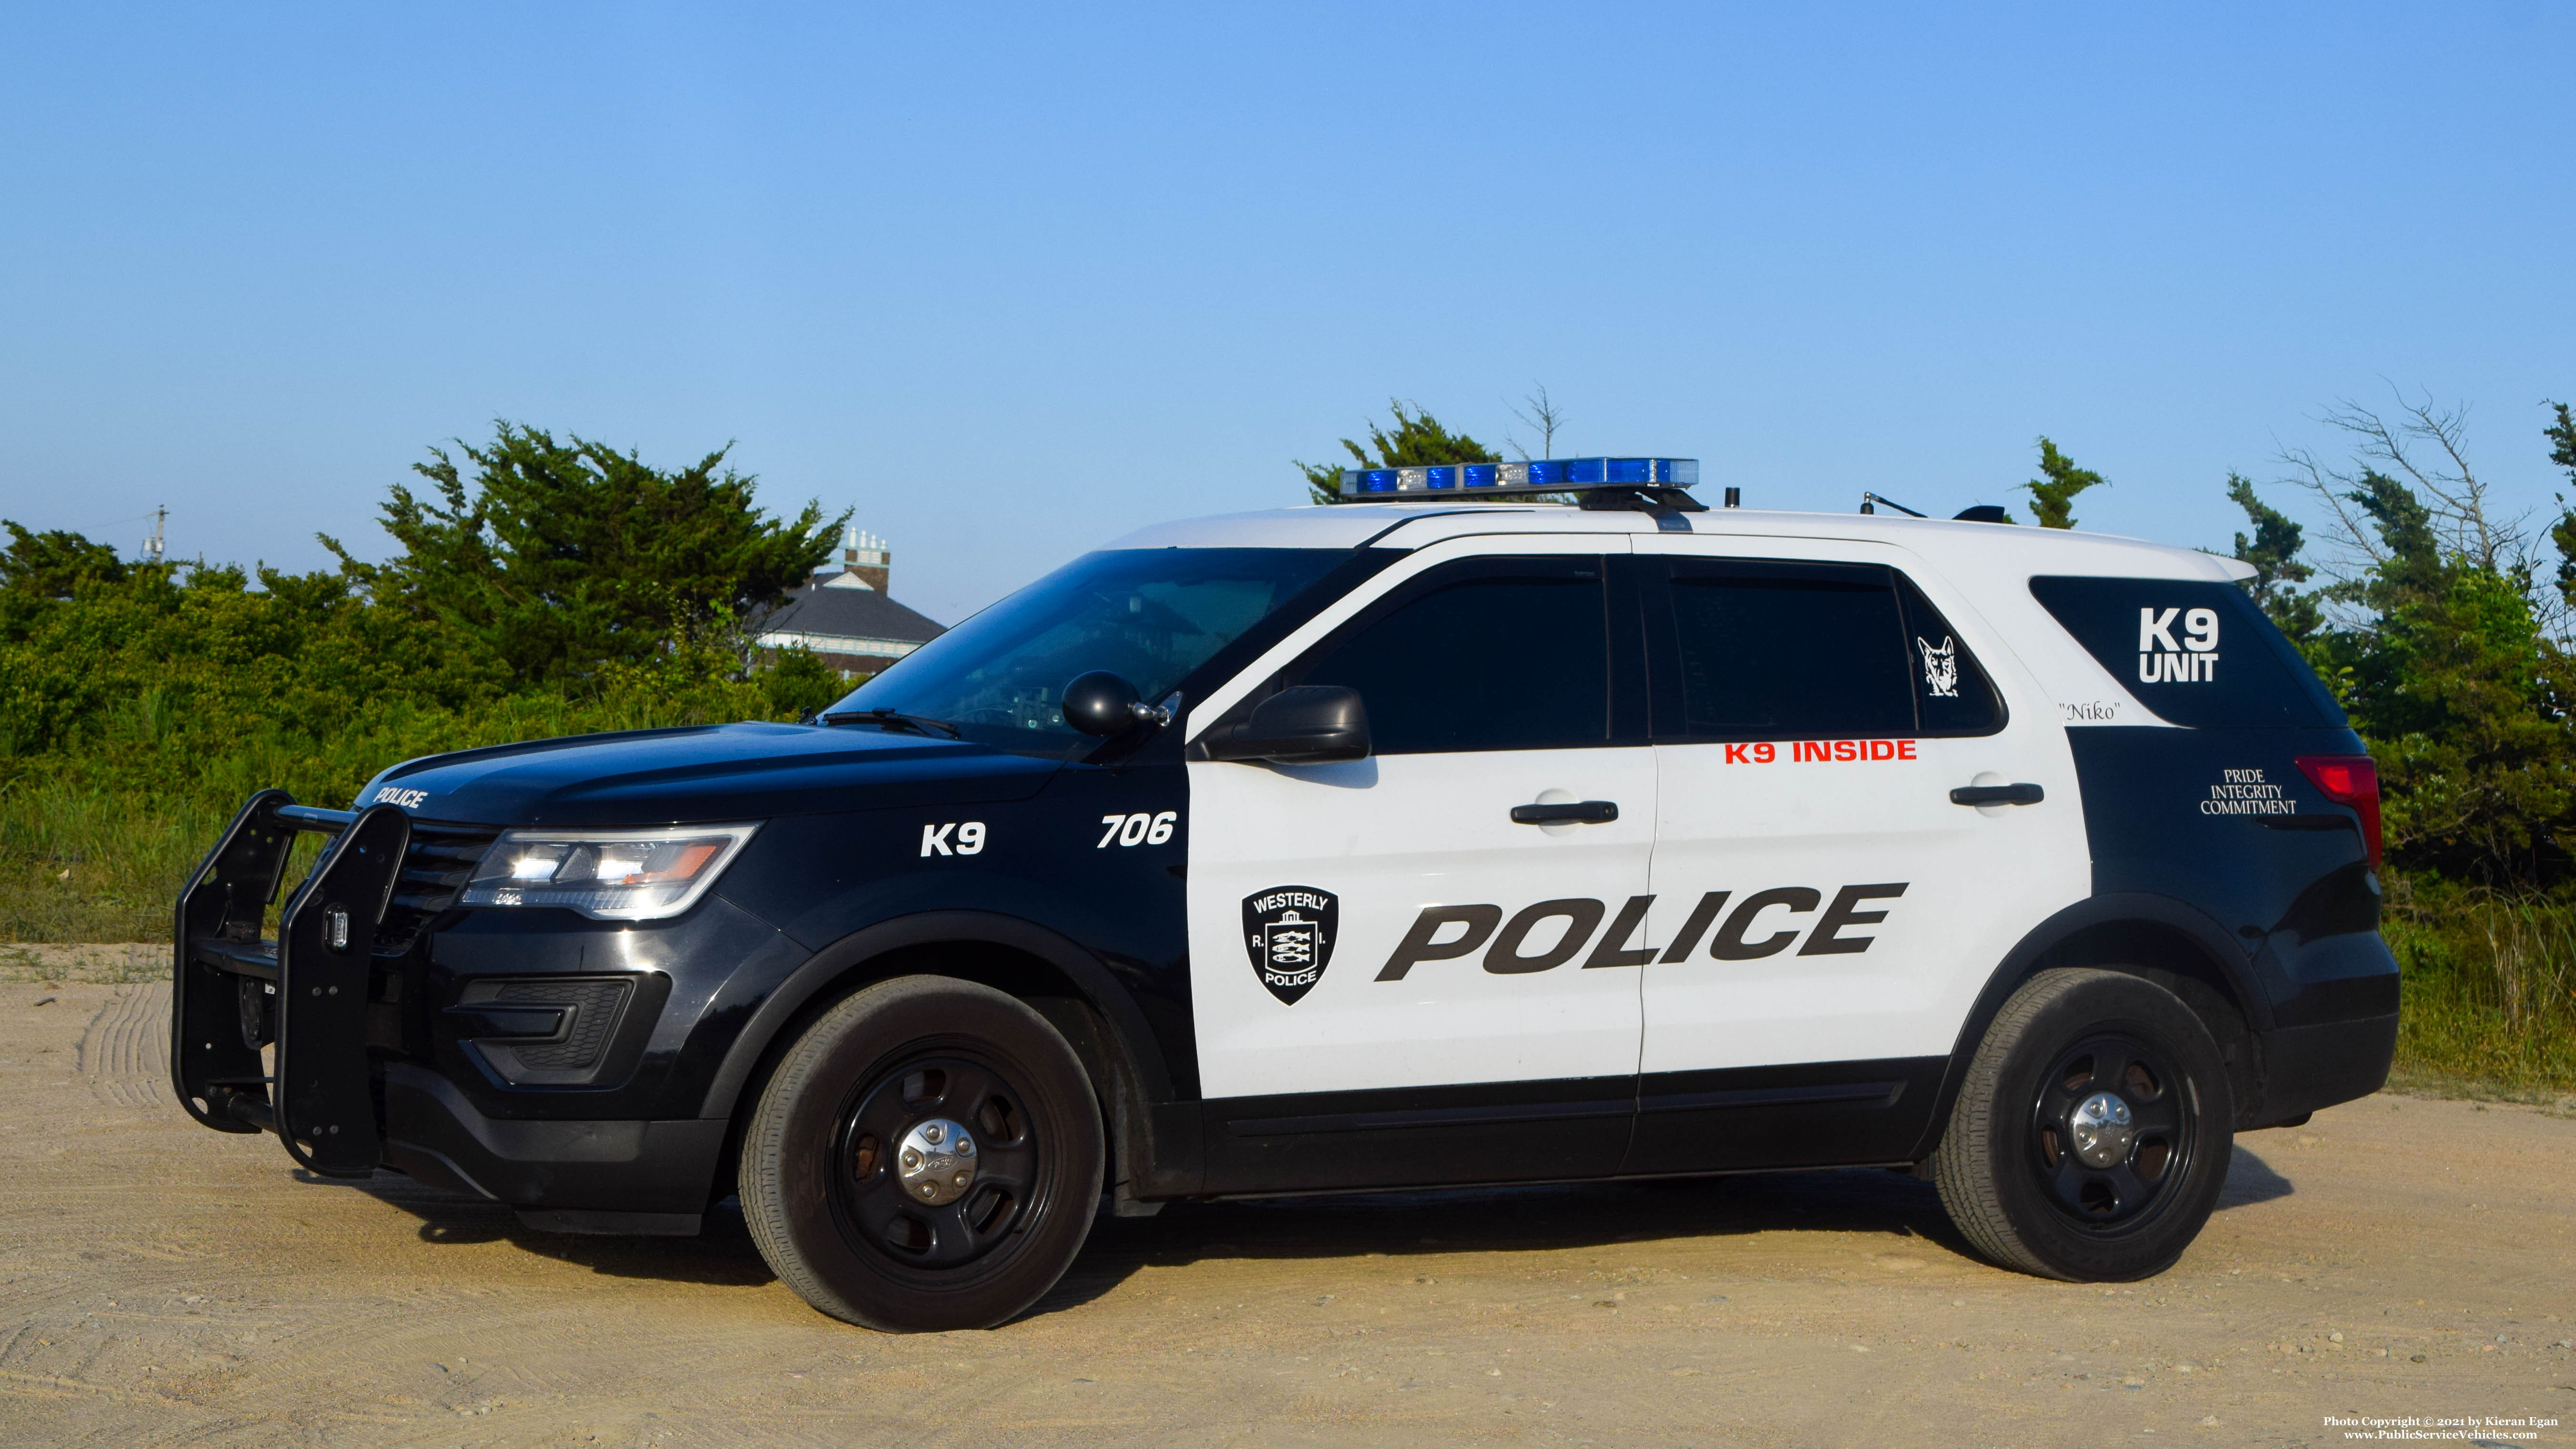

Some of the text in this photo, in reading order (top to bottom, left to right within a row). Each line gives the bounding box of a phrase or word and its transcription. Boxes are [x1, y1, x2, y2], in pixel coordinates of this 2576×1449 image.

[2140, 608, 2218, 651] K9
[2140, 654, 2218, 683] UNIT
[2059, 701, 2120, 720] "Niko"
[1725, 740, 1916, 764] K9 INSIDE
[2224, 770, 2264, 782] PRIDE
[373, 787, 428, 808] POLICE
[2212, 785, 2281, 798] INTEGRITY
[2201, 801, 2295, 814] COMMITMENT
[921, 822, 986, 856] K9
[1097, 812, 1177, 848] 706
[1254, 893, 1328, 914] WESTERLY
[1253, 933, 1325, 947] R. I.
[1374, 883, 1909, 982] POLICE
[1266, 970, 1316, 986] POLICE
